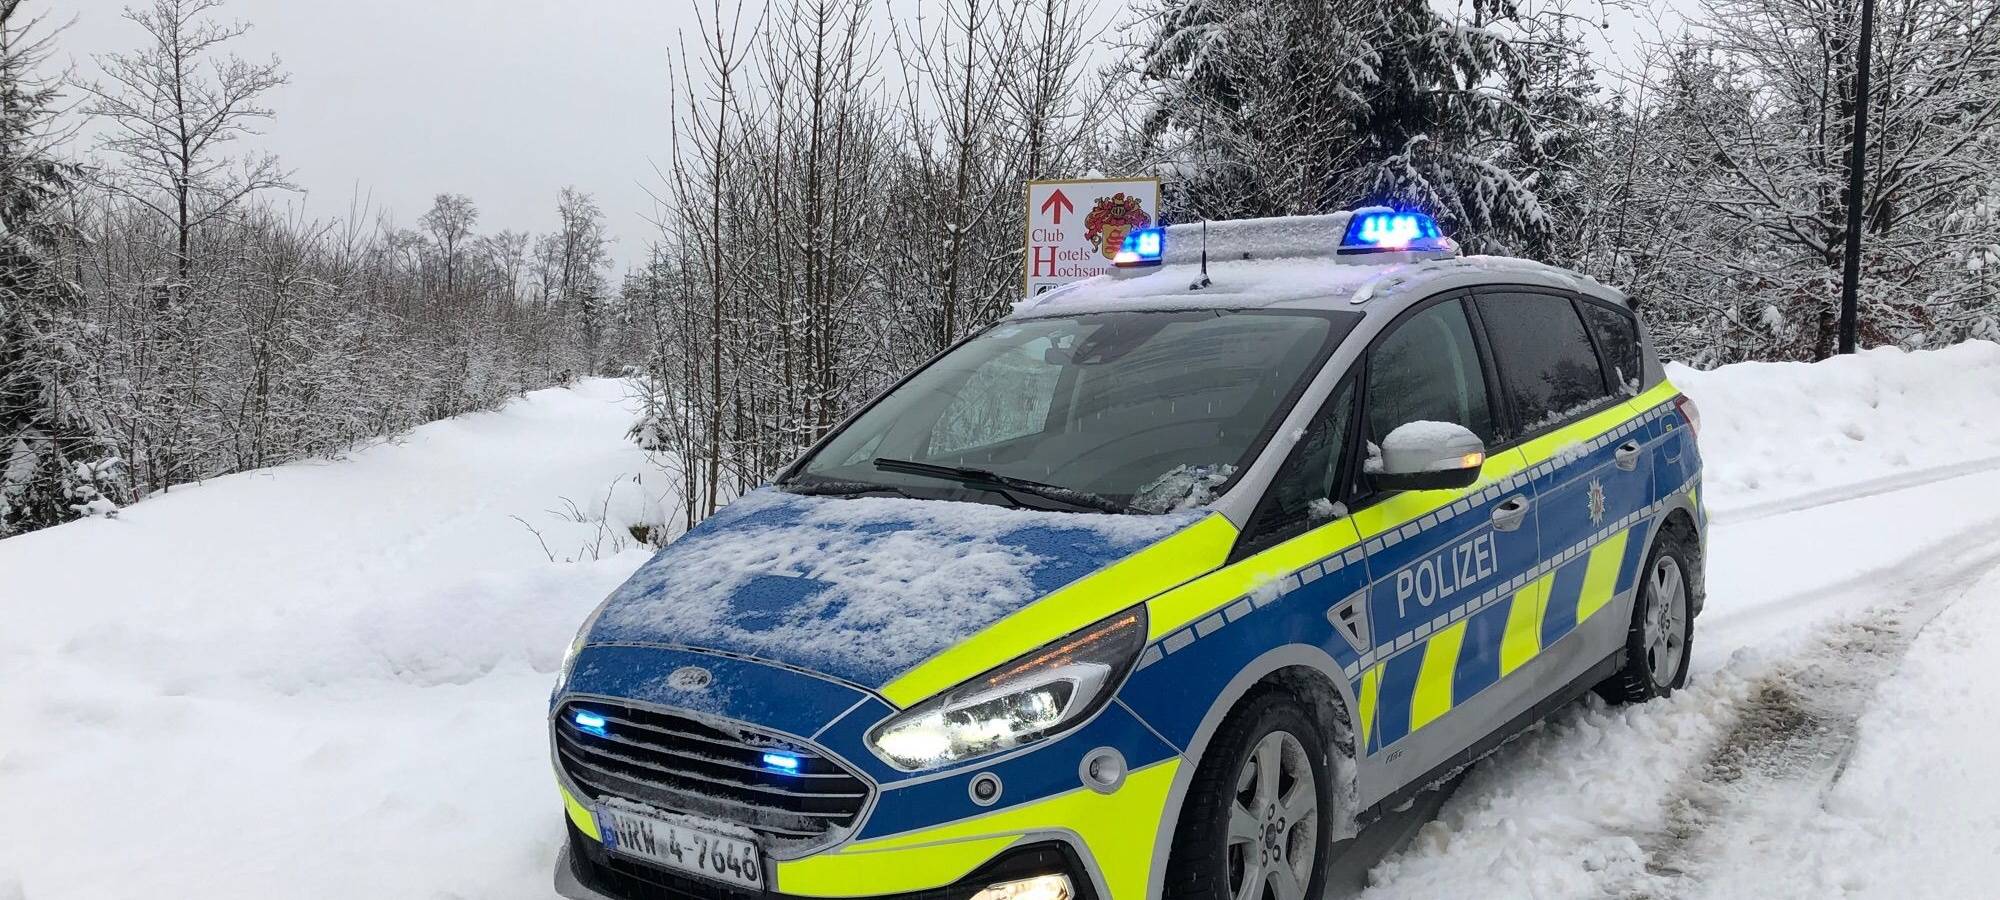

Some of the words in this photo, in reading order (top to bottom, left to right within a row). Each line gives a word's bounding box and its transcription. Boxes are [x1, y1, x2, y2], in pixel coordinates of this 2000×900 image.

[1032, 229, 1064, 242] Club
[1031, 246, 1090, 277] Hotels
[1397, 531, 1497, 618] POLIZEI
[611, 813, 656, 856] NRW
